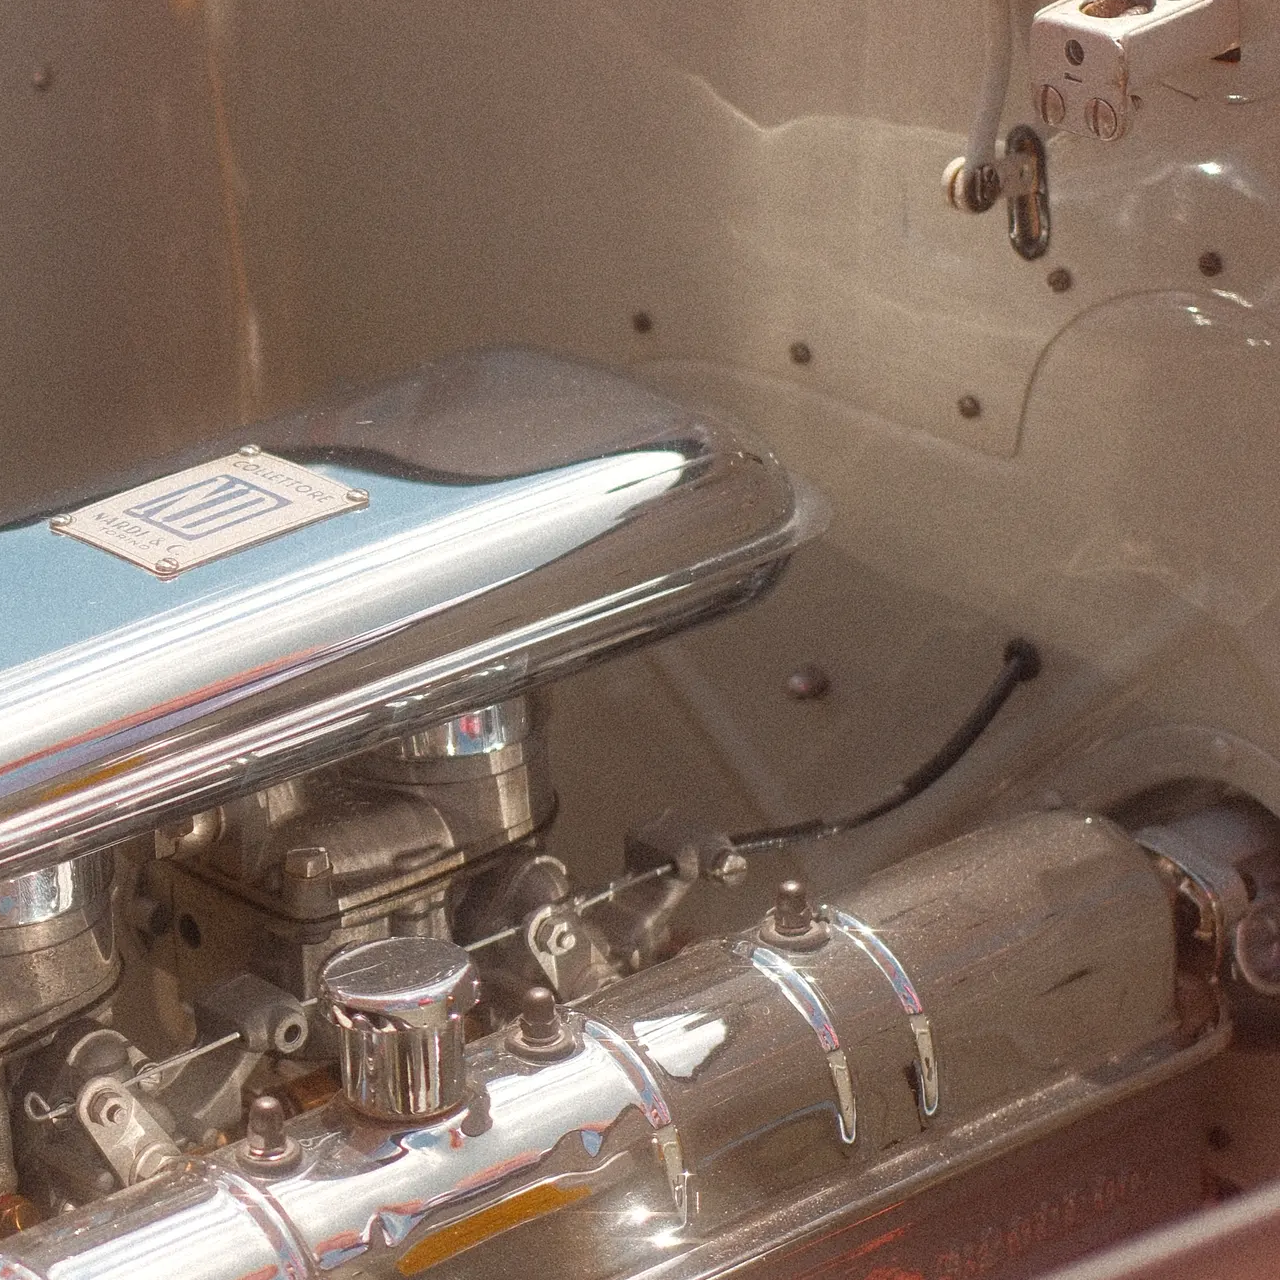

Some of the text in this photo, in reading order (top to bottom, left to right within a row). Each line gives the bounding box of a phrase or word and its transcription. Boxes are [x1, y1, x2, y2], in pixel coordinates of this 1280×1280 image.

[232, 460, 335, 503] COLLETTORE
[93, 512, 150, 538] NARDI
[151, 536, 166, 547] &
[99, 526, 151, 550] TORINO
